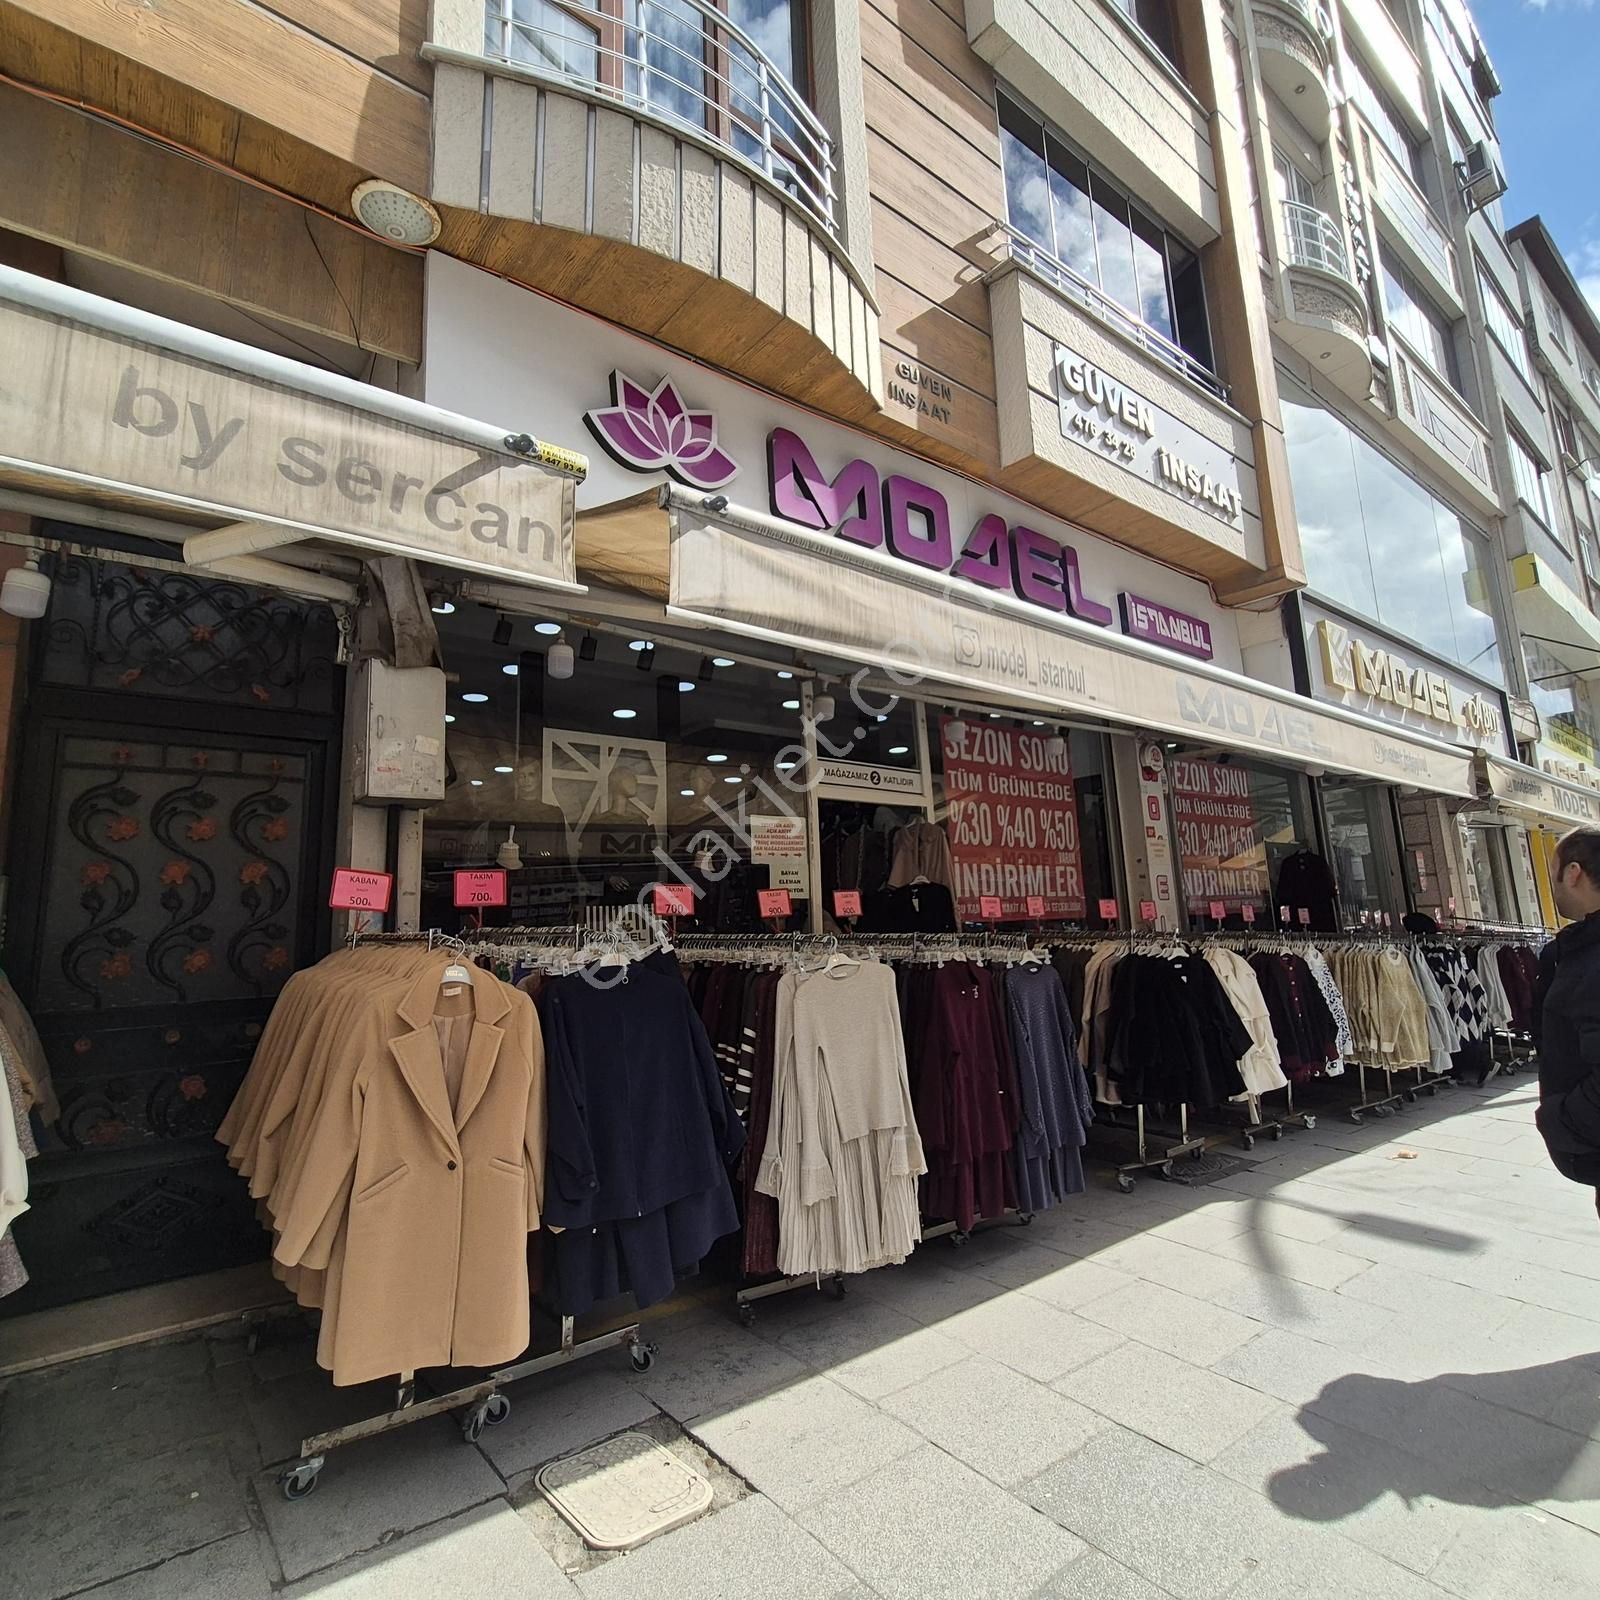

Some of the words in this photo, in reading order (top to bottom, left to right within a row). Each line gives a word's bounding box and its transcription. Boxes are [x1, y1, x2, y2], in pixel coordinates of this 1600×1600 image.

[112, 364, 246, 470] by
[276, 433, 557, 564] sercan
[766, 427, 1112, 627] MODEL
[871, 771, 881, 785] 2
[948, 768, 982, 792] TÜM
[988, 772, 1073, 802] ÜRÜNLERDE
[1170, 759, 1210, 794] EZON
[1213, 766, 1249, 798] SONU
[1194, 797, 1251, 820] ÜRÜNLERDE
[1550, 785, 1593, 819] MODEL
[950, 800, 993, 847] %30
[997, 804, 1036, 849] %40
[1039, 808, 1076, 851] %50
[1201, 822, 1229, 858] %40
[1230, 825, 1256, 858] %50
[349, 875, 378, 885] KABAN
[469, 873, 493, 881] TAKIM
[953, 856, 1080, 898] İNDİRİMLER
[1183, 865, 1262, 897] NDİRİMLER
